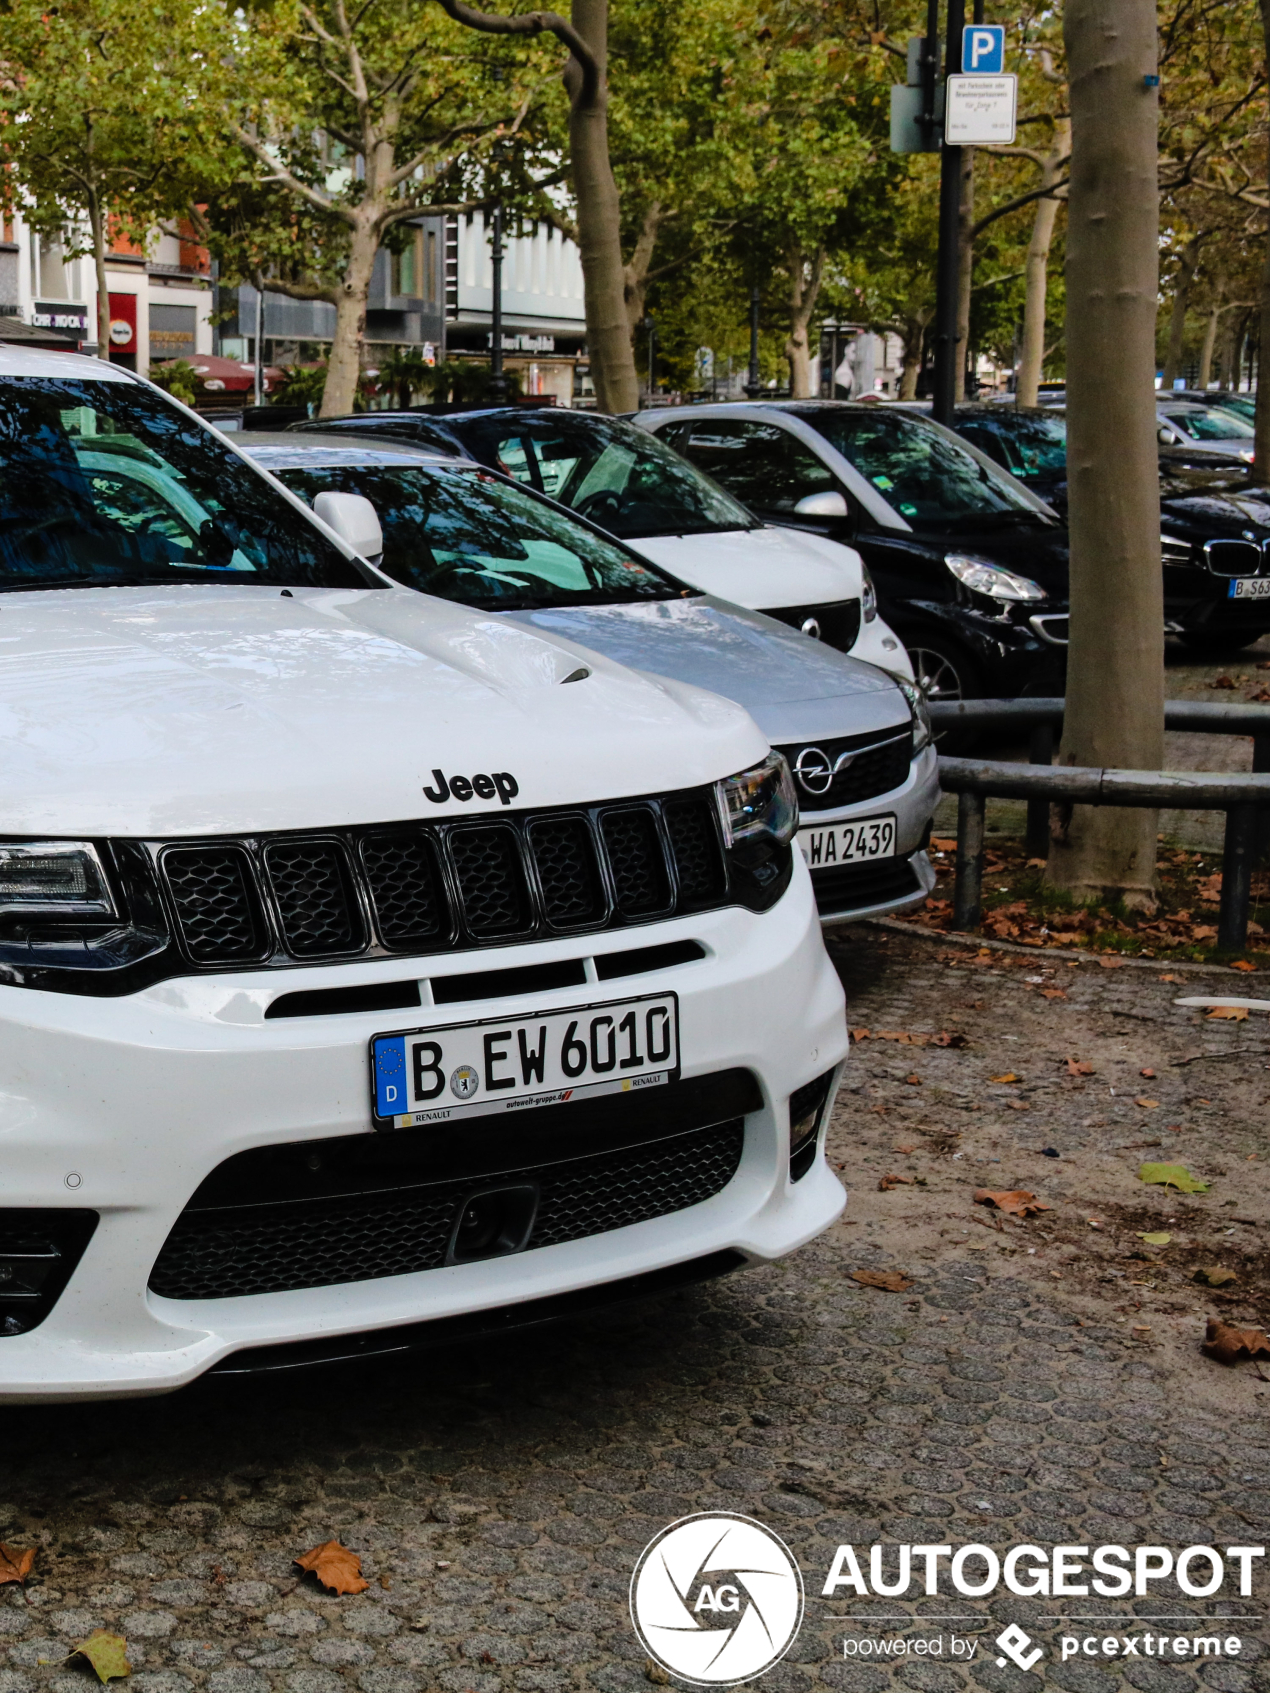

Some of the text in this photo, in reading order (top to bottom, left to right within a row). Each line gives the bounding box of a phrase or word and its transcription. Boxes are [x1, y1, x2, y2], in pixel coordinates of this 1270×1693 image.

[971, 31, 995, 68] P
[1235, 581, 1244, 595] B
[422, 768, 520, 806] Jeep
[810, 822, 893, 865] WA 2439
[411, 1005, 671, 1102] B EW 6010
[386, 1085, 398, 1102] D
[632, 1074, 661, 1087] RENAULT
[415, 1110, 452, 1123] RENAULT
